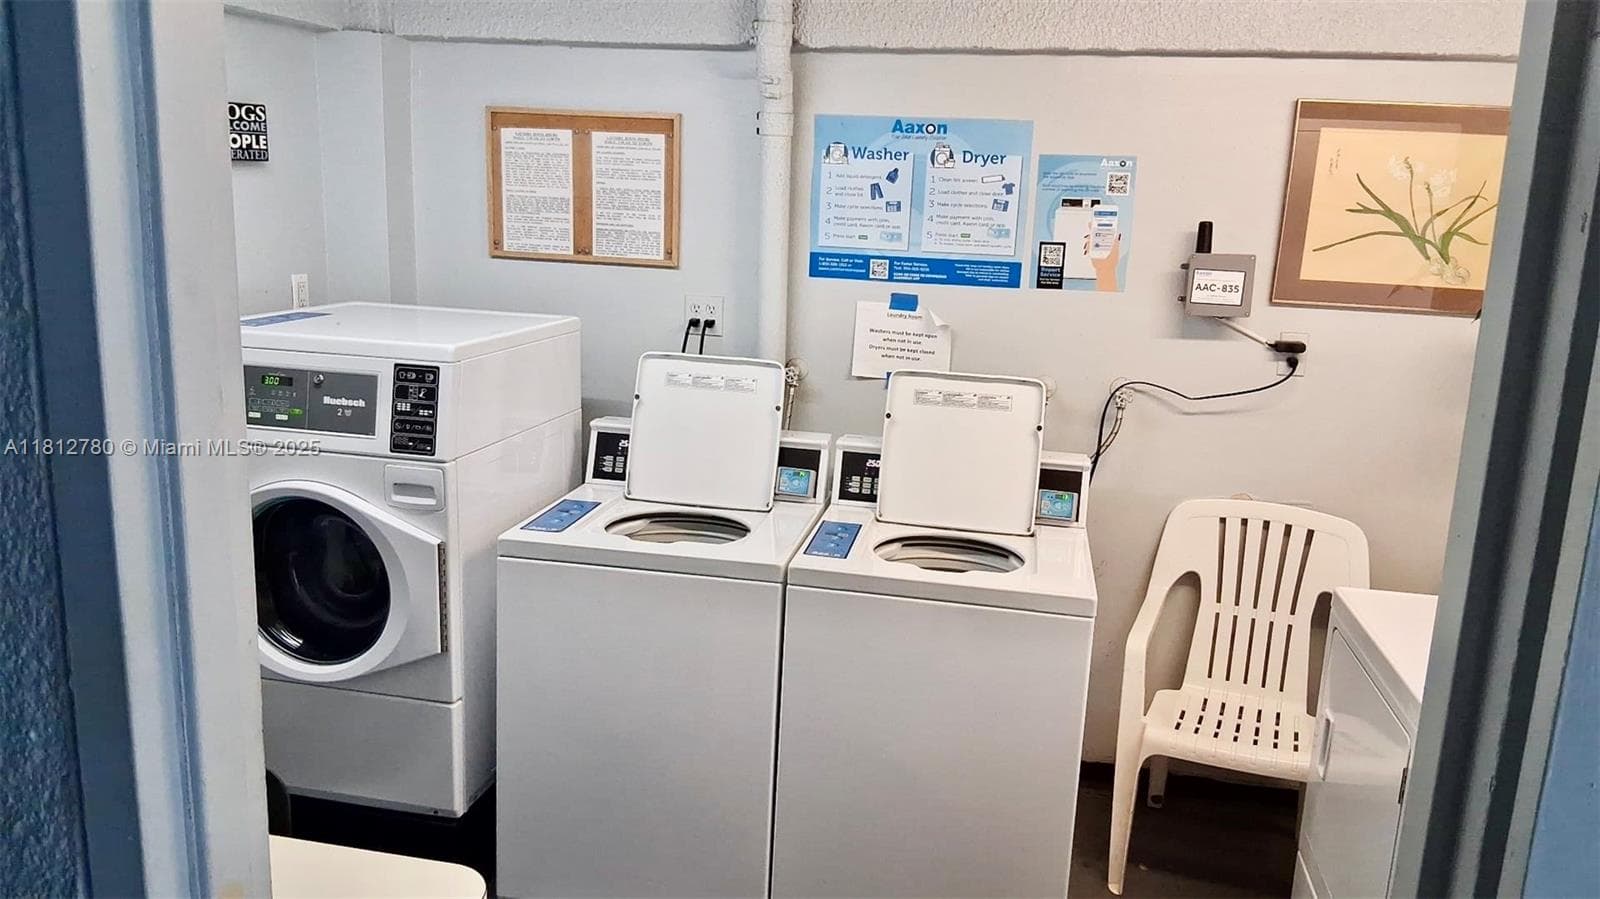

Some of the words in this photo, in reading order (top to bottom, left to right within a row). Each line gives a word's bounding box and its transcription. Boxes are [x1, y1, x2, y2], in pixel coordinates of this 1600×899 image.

[228, 104, 265, 121] OGS
[230, 121, 266, 132] COME
[891, 119, 948, 134] Aaxon
[230, 133, 267, 149] OPLE
[231, 150, 268, 160] ERATED
[852, 146, 909, 161] Washer
[962, 150, 1006, 167] Dryer
[1101, 158, 1133, 167] Aaxon
[826, 187, 832, 195] 2
[929, 188, 935, 196] 2
[824, 232, 830, 240] 5
[927, 231, 933, 239] 5
[1195, 283, 1240, 293] AAC-835
[323, 395, 366, 408] Huebsch
[337, 408, 342, 416] 2
